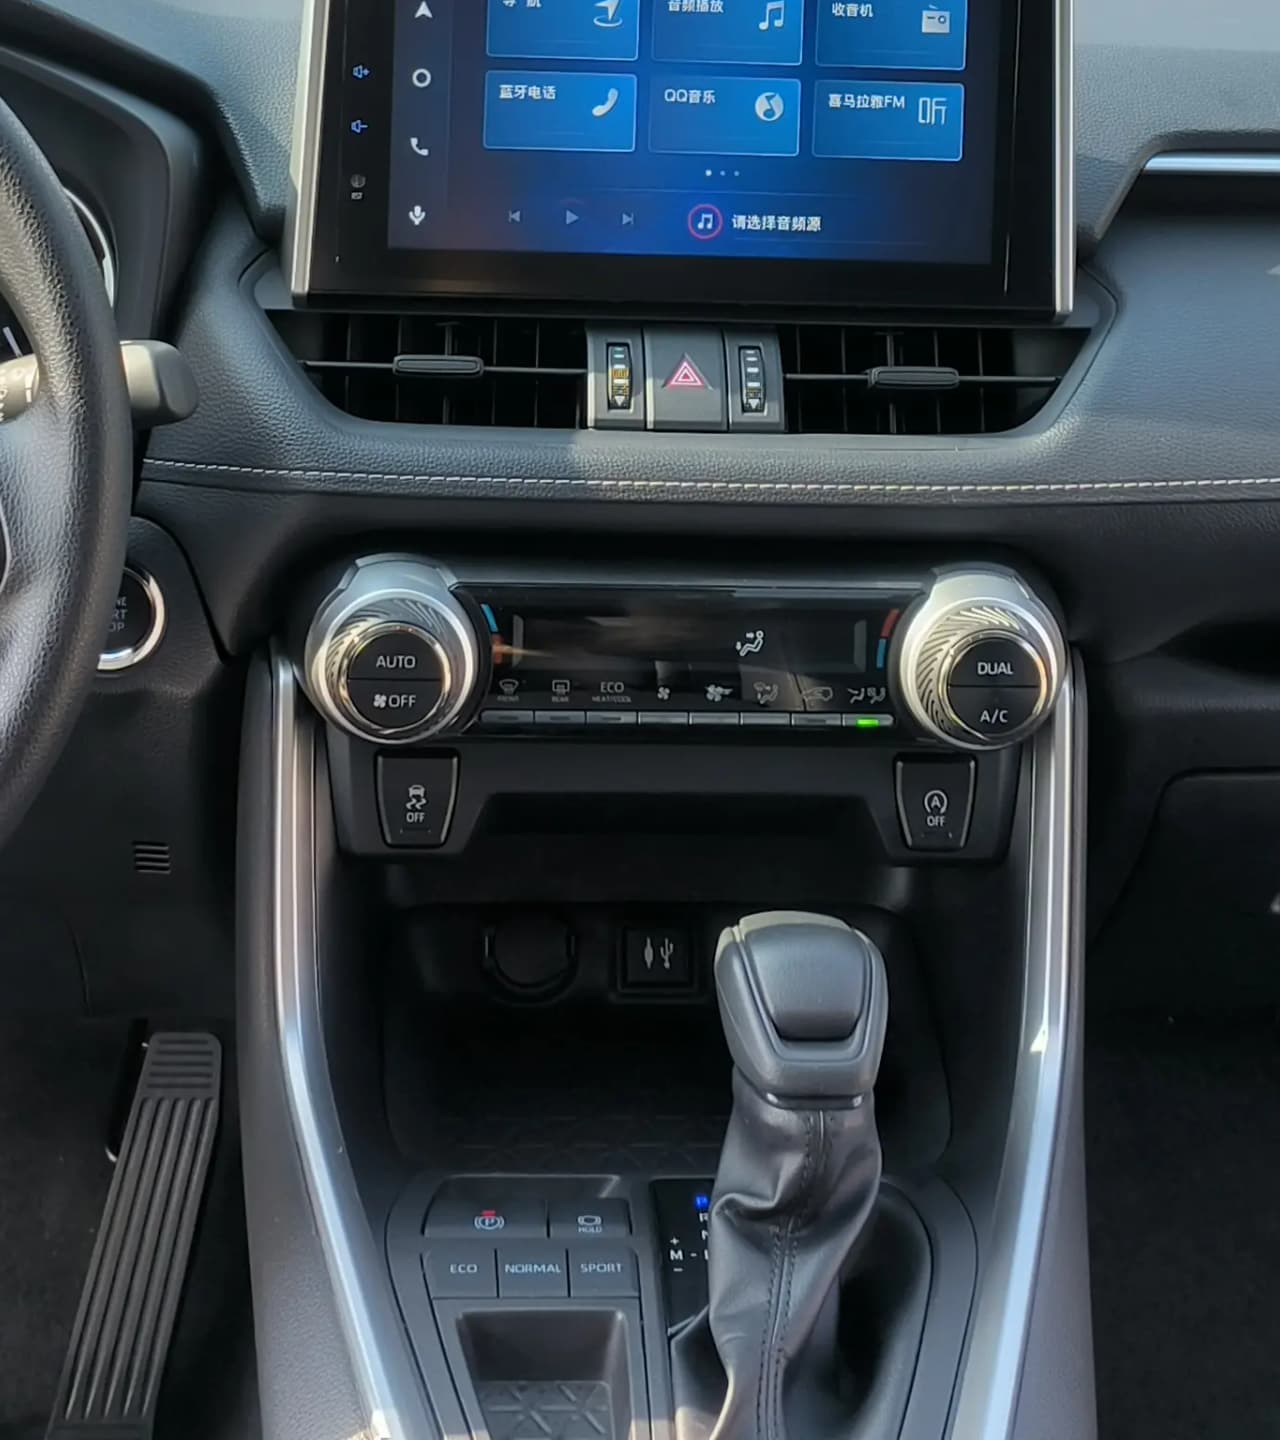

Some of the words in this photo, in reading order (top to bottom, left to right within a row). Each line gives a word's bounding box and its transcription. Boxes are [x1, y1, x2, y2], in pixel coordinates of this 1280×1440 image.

[831, 2, 874, 18] 收音机
[499, 85, 557, 101] 蓝牙电话
[664, 88, 716, 105] QQ音乐
[828, 93, 906, 110] 喜马拉雅FM
[732, 214, 822, 232] 请选择音频源
[376, 655, 416, 669] AUTO
[977, 662, 1014, 676] DUAL
[600, 681, 625, 693] ECO
[388, 695, 416, 708] OFF
[980, 709, 1008, 724] A/C
[406, 812, 425, 823] OFF
[927, 816, 945, 827] OFF
[670, 1249, 683, 1261] M
[450, 1263, 478, 1274] ECO
[505, 1263, 561, 1274] NORMAL
[581, 1262, 622, 1273] SPORT
